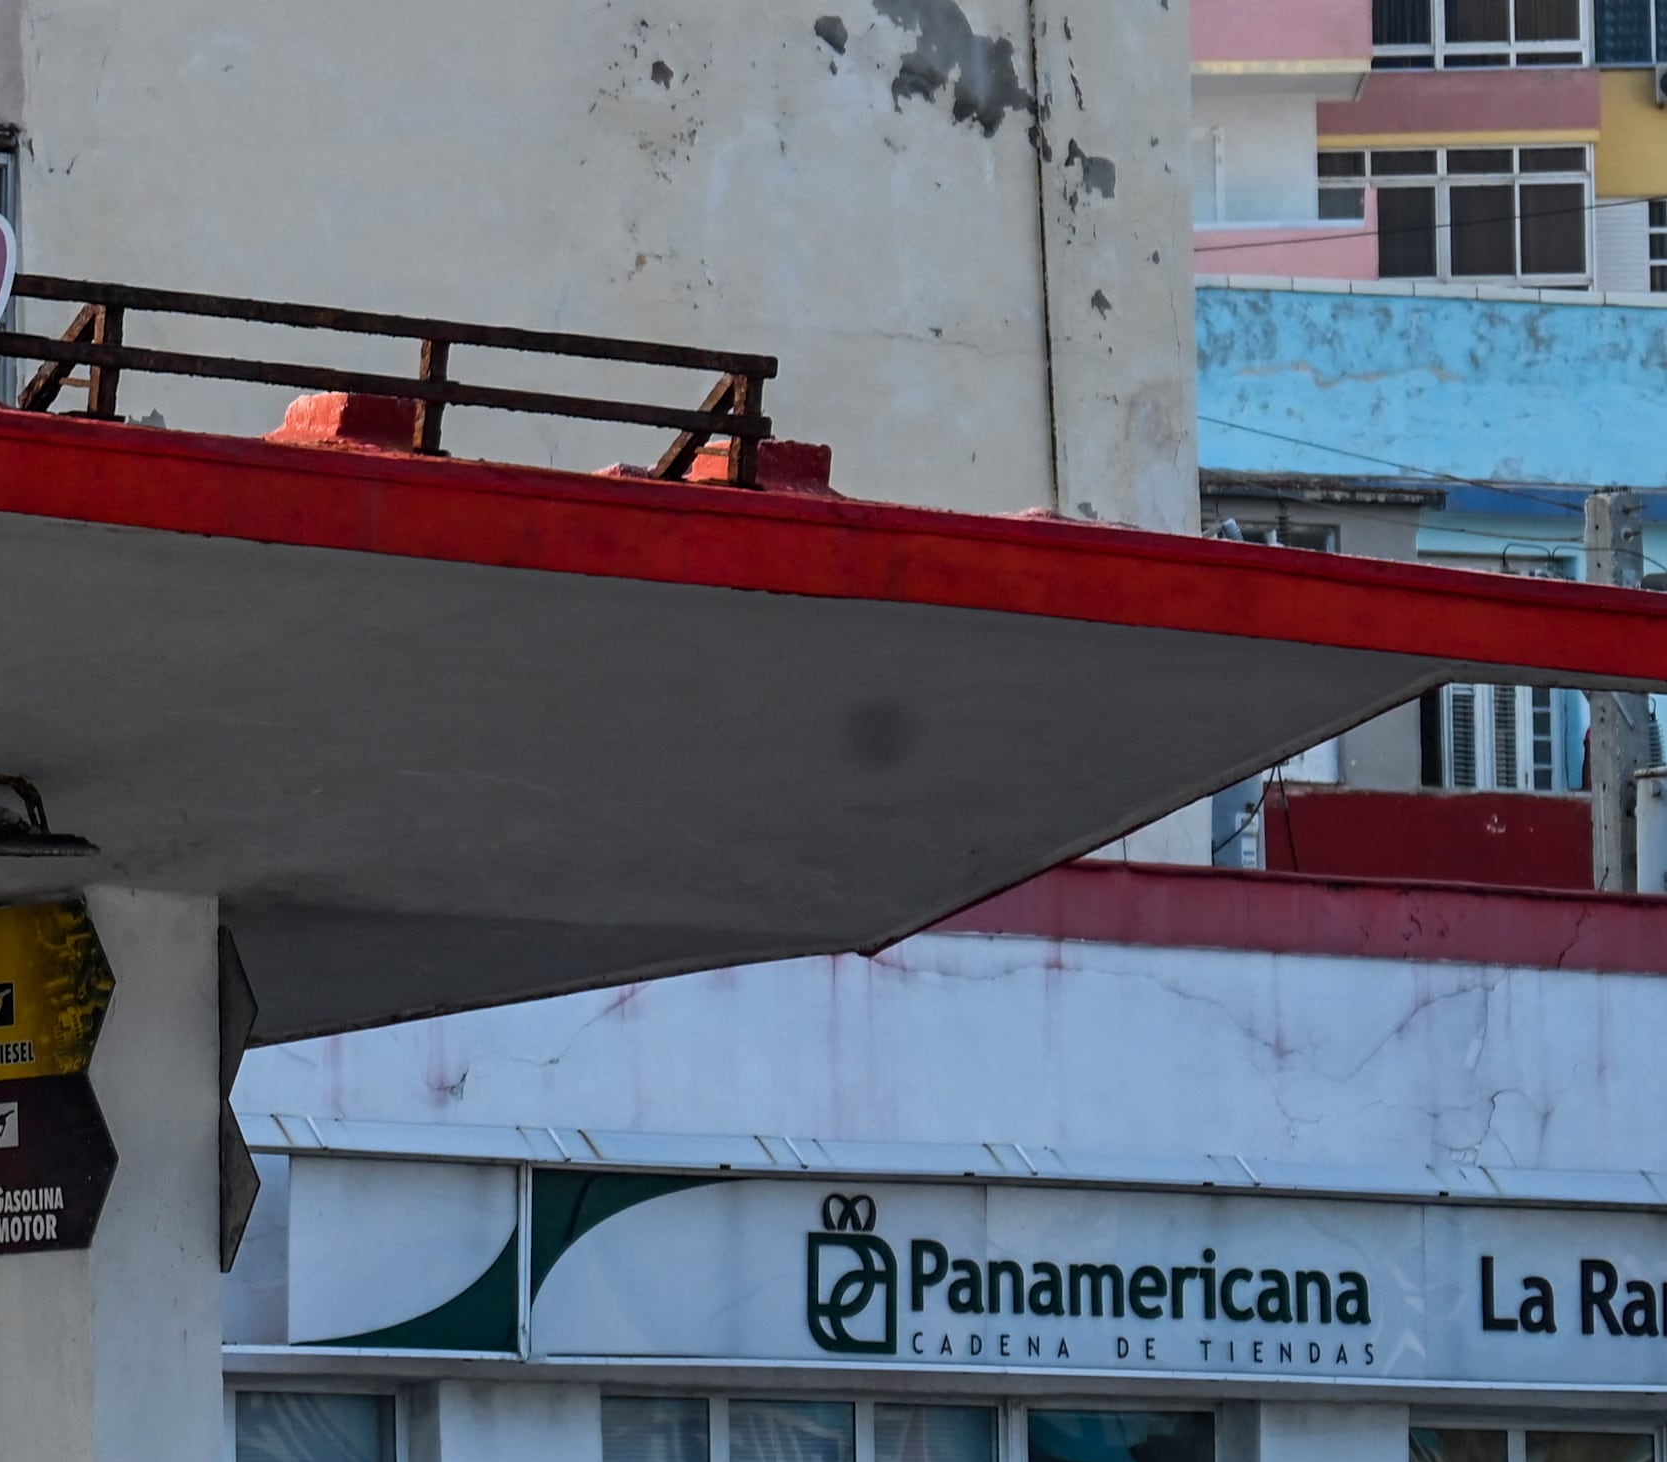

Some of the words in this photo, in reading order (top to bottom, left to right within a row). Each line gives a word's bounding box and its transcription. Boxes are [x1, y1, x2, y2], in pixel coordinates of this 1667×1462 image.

[911, 1239, 1372, 1325] Panamericana
[1481, 1255, 1557, 1334] La
[1580, 1258, 1667, 1338] Ra
[912, 1331, 1070, 1359] CADENA
[1117, 1337, 1156, 1360] DE
[1200, 1339, 1374, 1366] TIENDAS
